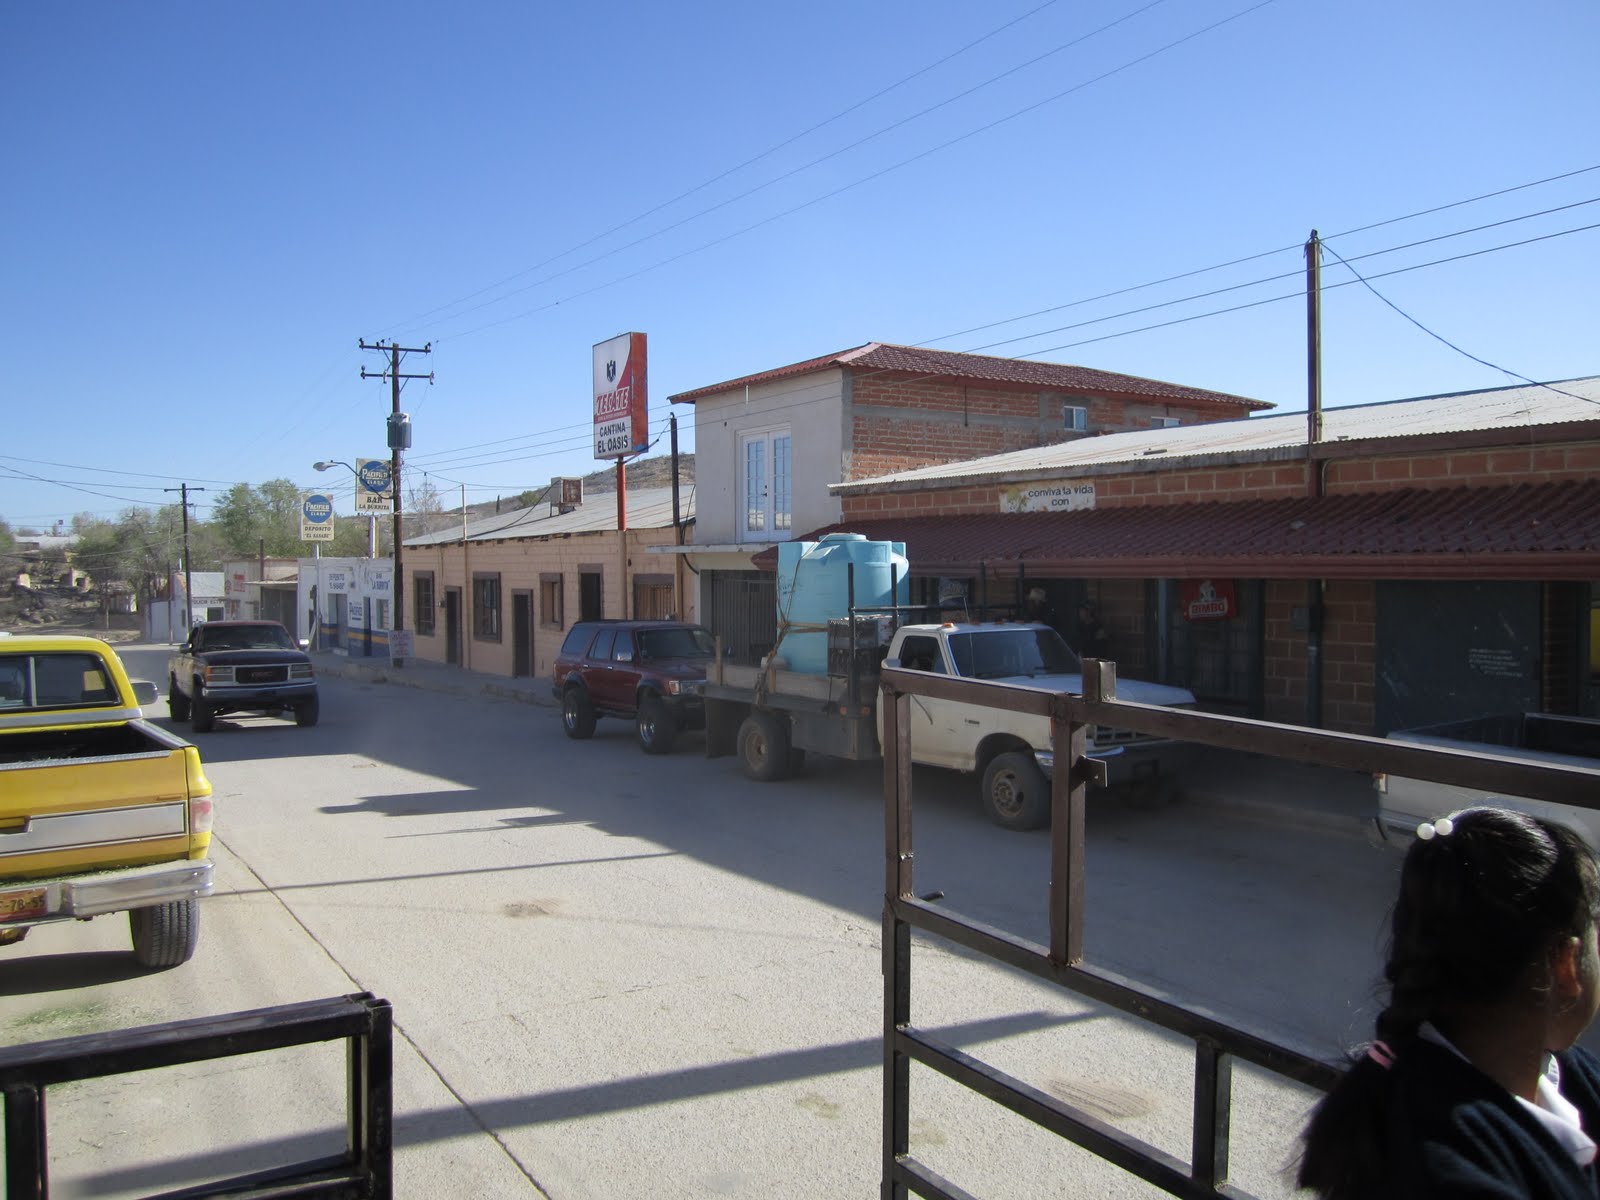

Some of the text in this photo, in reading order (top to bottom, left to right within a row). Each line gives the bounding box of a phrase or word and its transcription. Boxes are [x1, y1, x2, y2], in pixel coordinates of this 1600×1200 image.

[597, 387, 630, 415] TECATE
[599, 422, 626, 438] CANTINA
[598, 435, 628, 454] EL OASIS
[1028, 485, 1093, 498] conviva la vida
[366, 496, 383, 504] BAR
[1051, 498, 1069, 506] con
[1191, 602, 1225, 614] BIMBO
